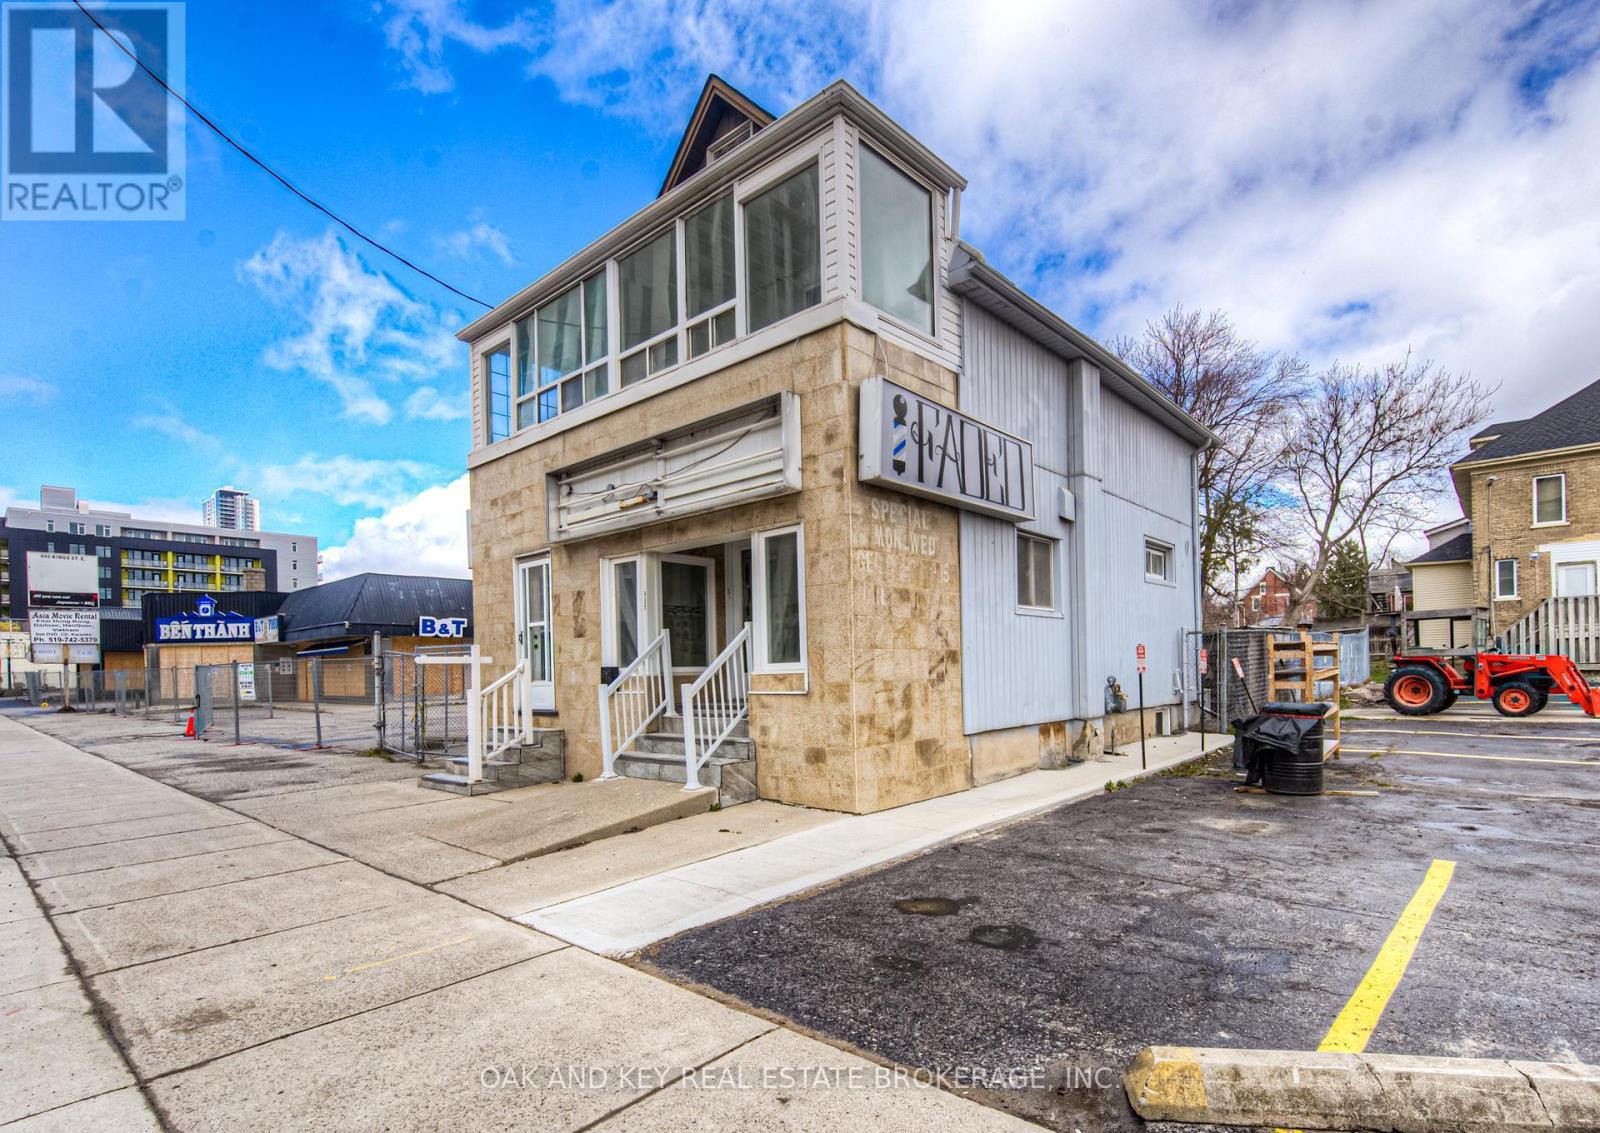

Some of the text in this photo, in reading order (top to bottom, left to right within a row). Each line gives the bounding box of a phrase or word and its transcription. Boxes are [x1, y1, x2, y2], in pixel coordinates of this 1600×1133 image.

[911, 400, 1025, 511] FADED
[871, 497, 929, 531] SPECIAL
[74, 612, 97, 620] Rental
[421, 618, 466, 635] B&T
